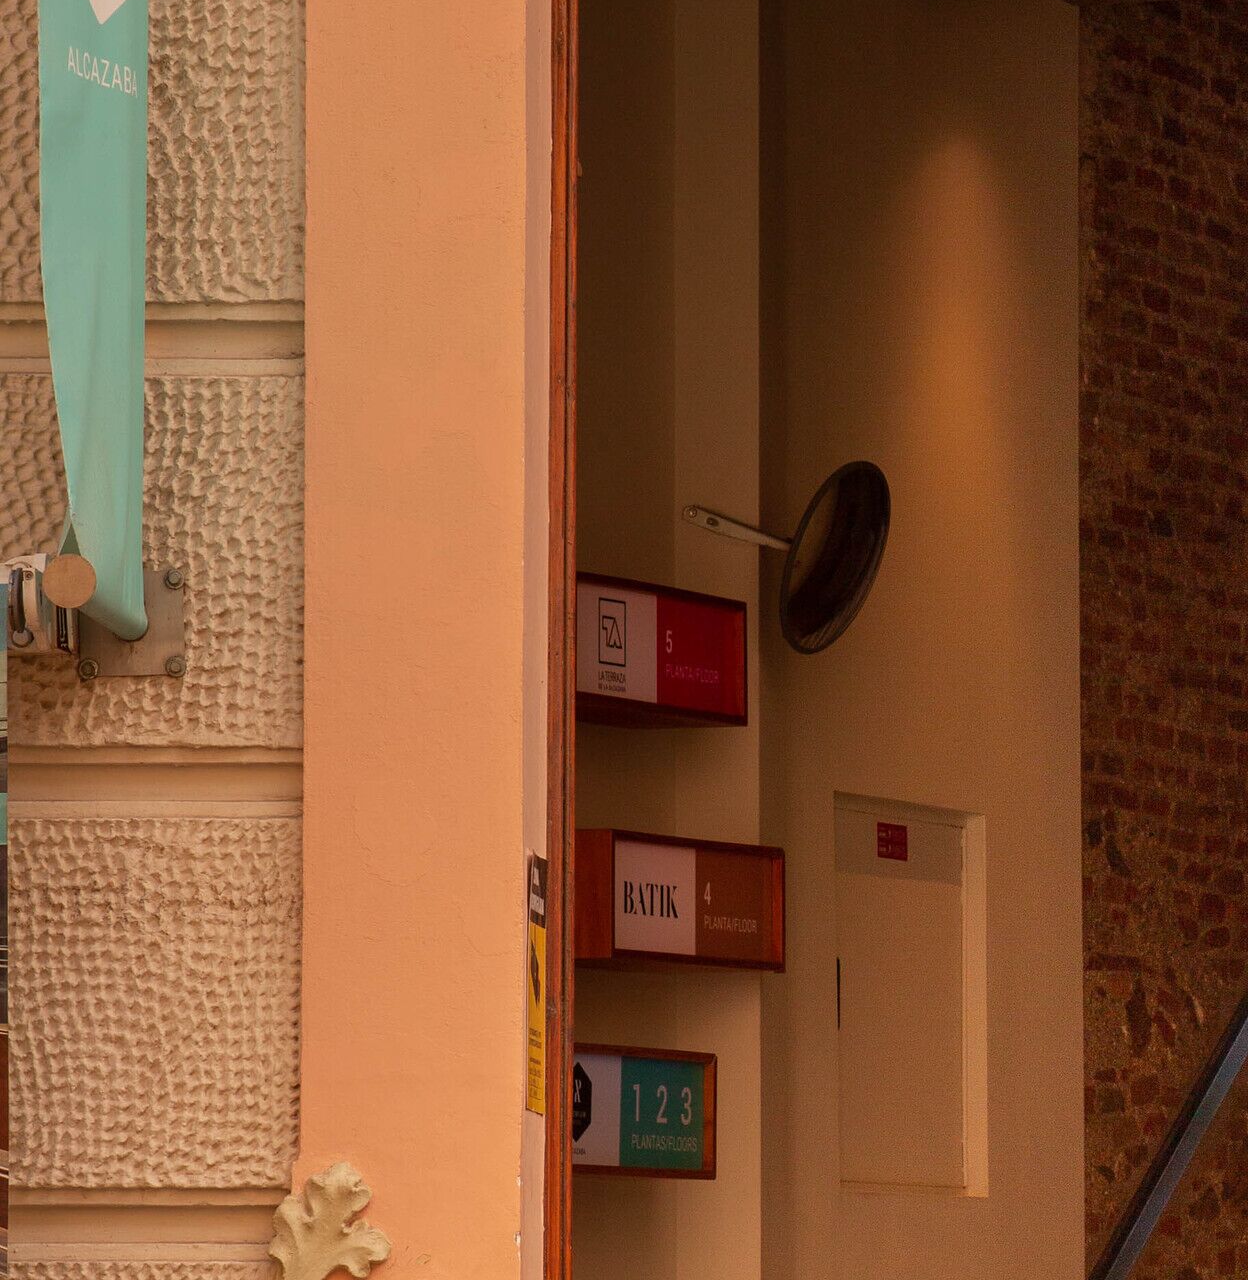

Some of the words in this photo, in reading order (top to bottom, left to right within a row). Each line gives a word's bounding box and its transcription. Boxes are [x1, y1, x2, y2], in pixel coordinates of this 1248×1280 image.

[67, 46, 138, 97] ALCAZABA
[665, 629, 673, 654] 5
[623, 880, 679, 919] BATIK
[703, 881, 712, 906] 4
[704, 915, 758, 934] PLANTA/FLOOR
[633, 1083, 641, 1122] 1
[656, 1084, 668, 1124] 2
[680, 1087, 692, 1126] 3
[631, 1133, 698, 1153] PLANTAS/FLOORS
